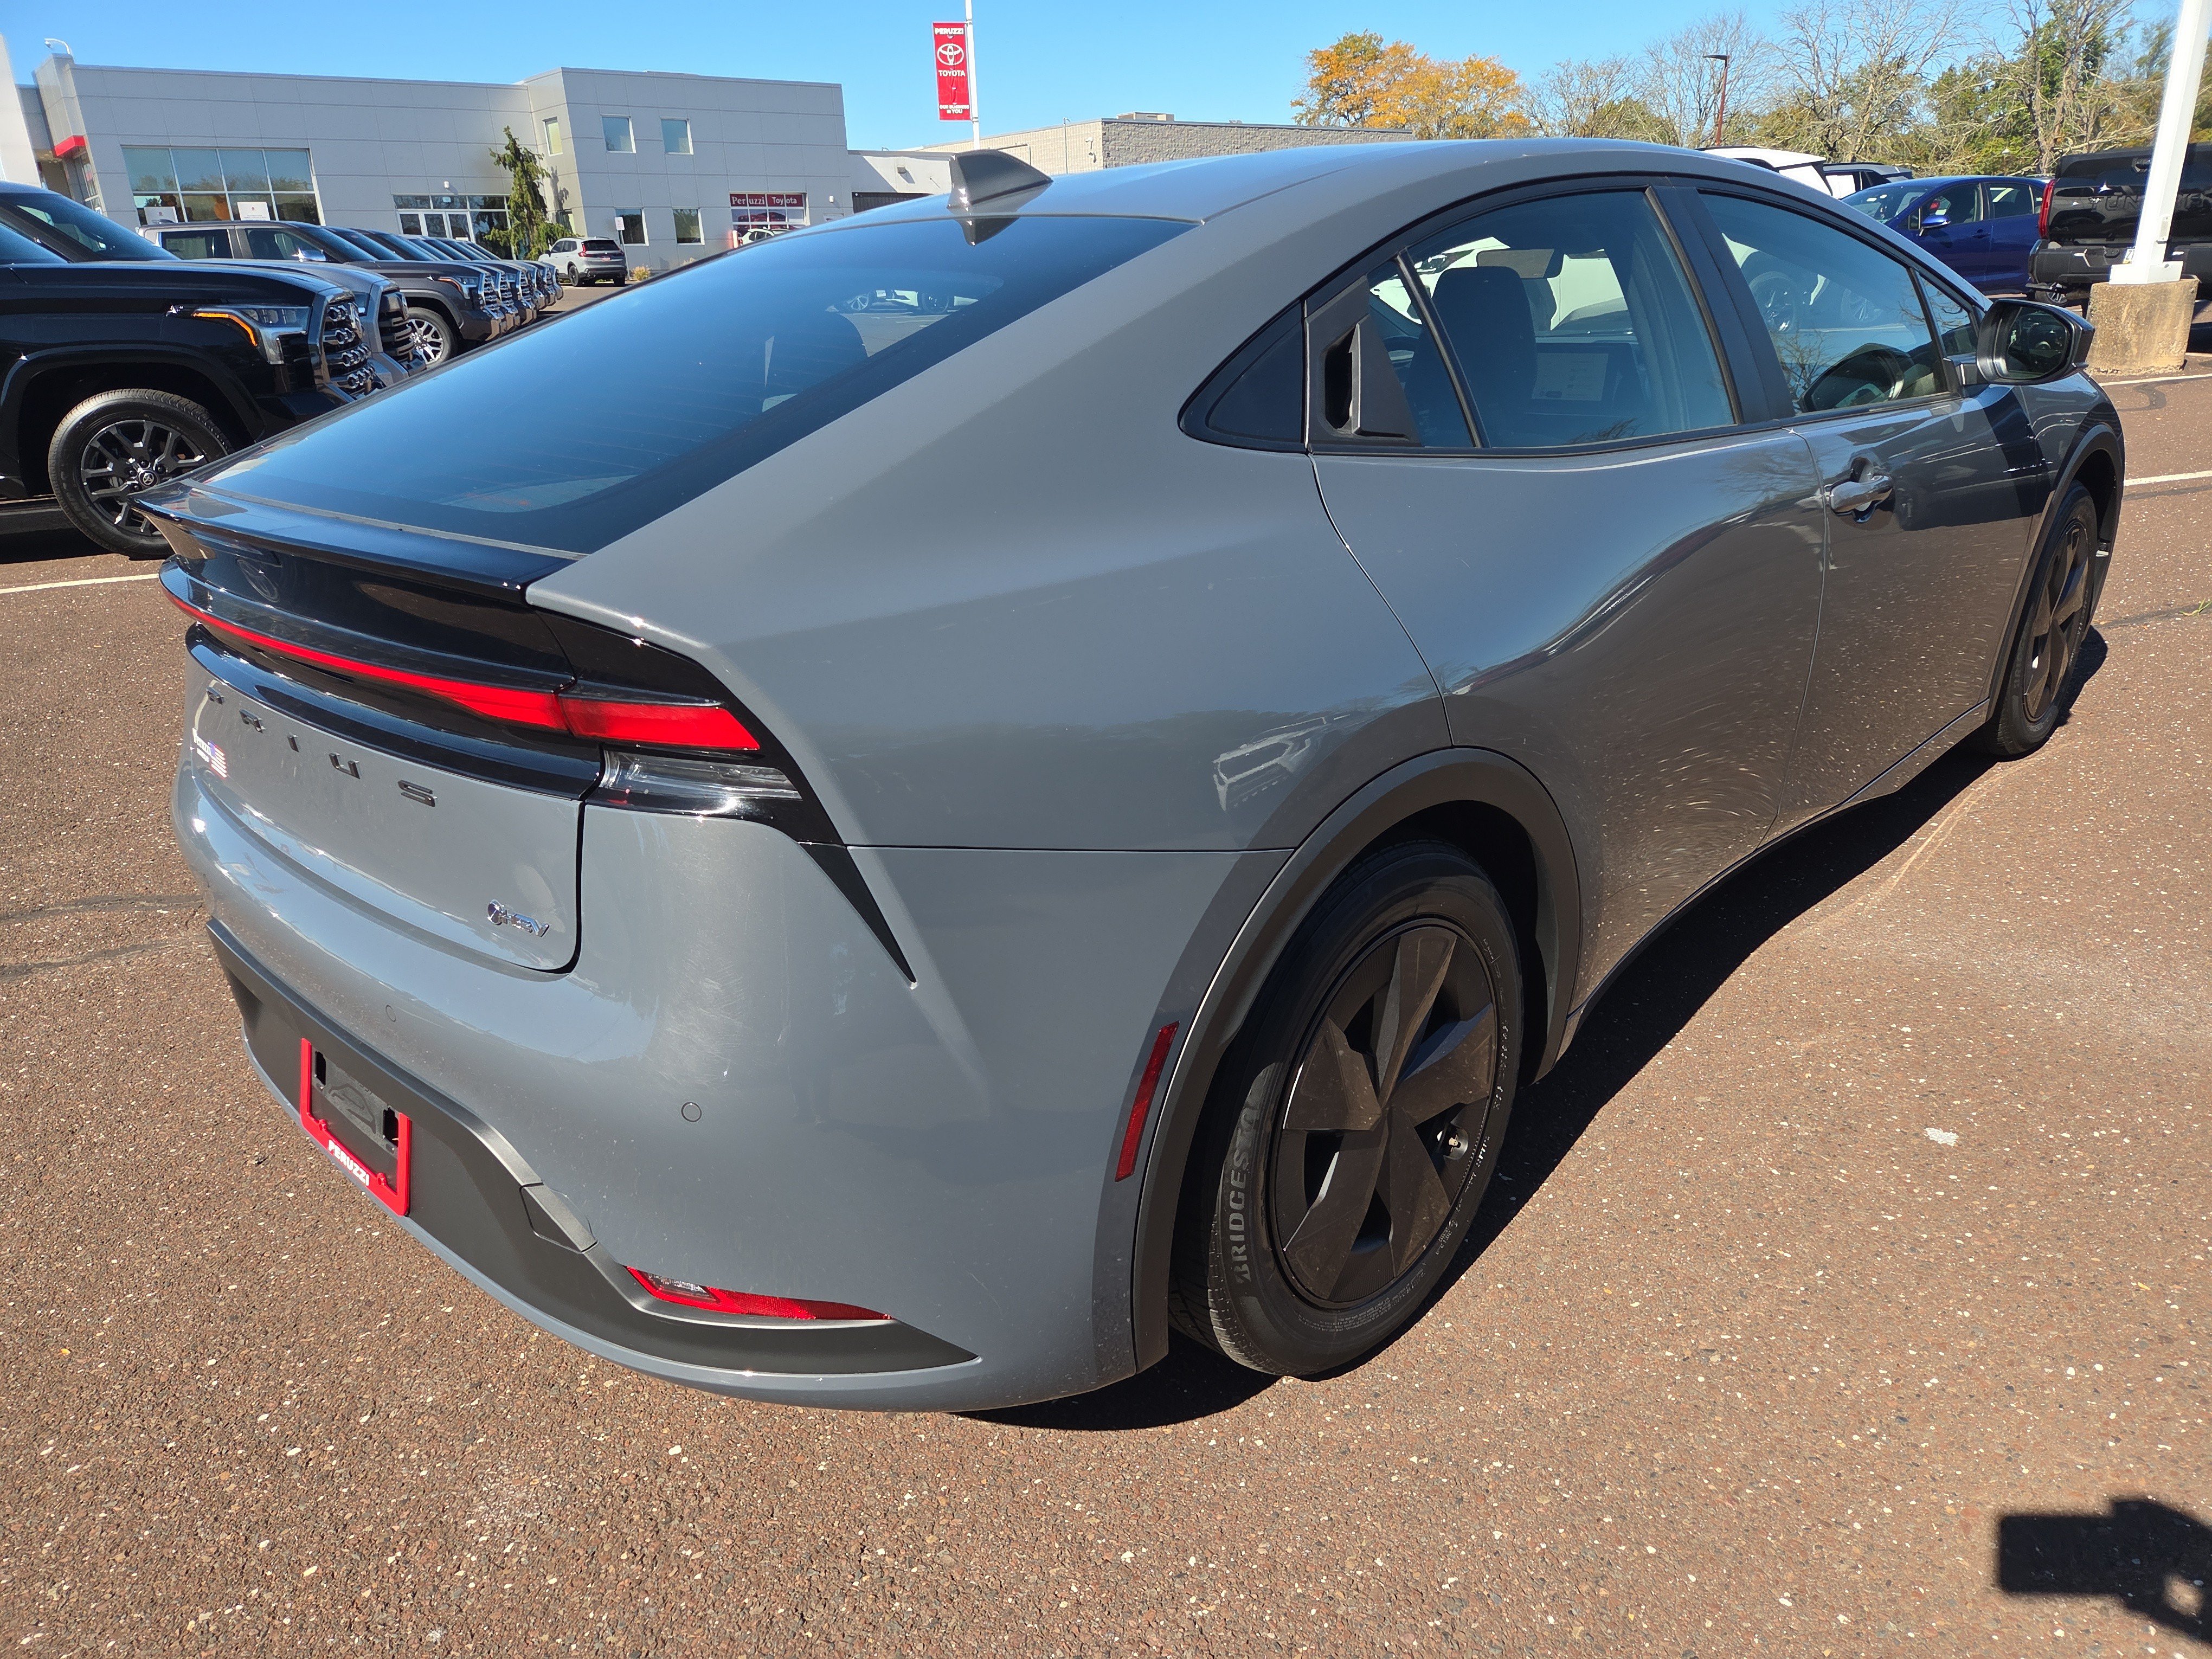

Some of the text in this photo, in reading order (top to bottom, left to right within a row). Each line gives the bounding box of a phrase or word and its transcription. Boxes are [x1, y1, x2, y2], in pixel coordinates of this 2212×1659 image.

[731, 196, 798, 205] Peruzzi Toyota
[205, 686, 437, 807] PRIUS
[327, 1140, 370, 1187] PERUZZI
